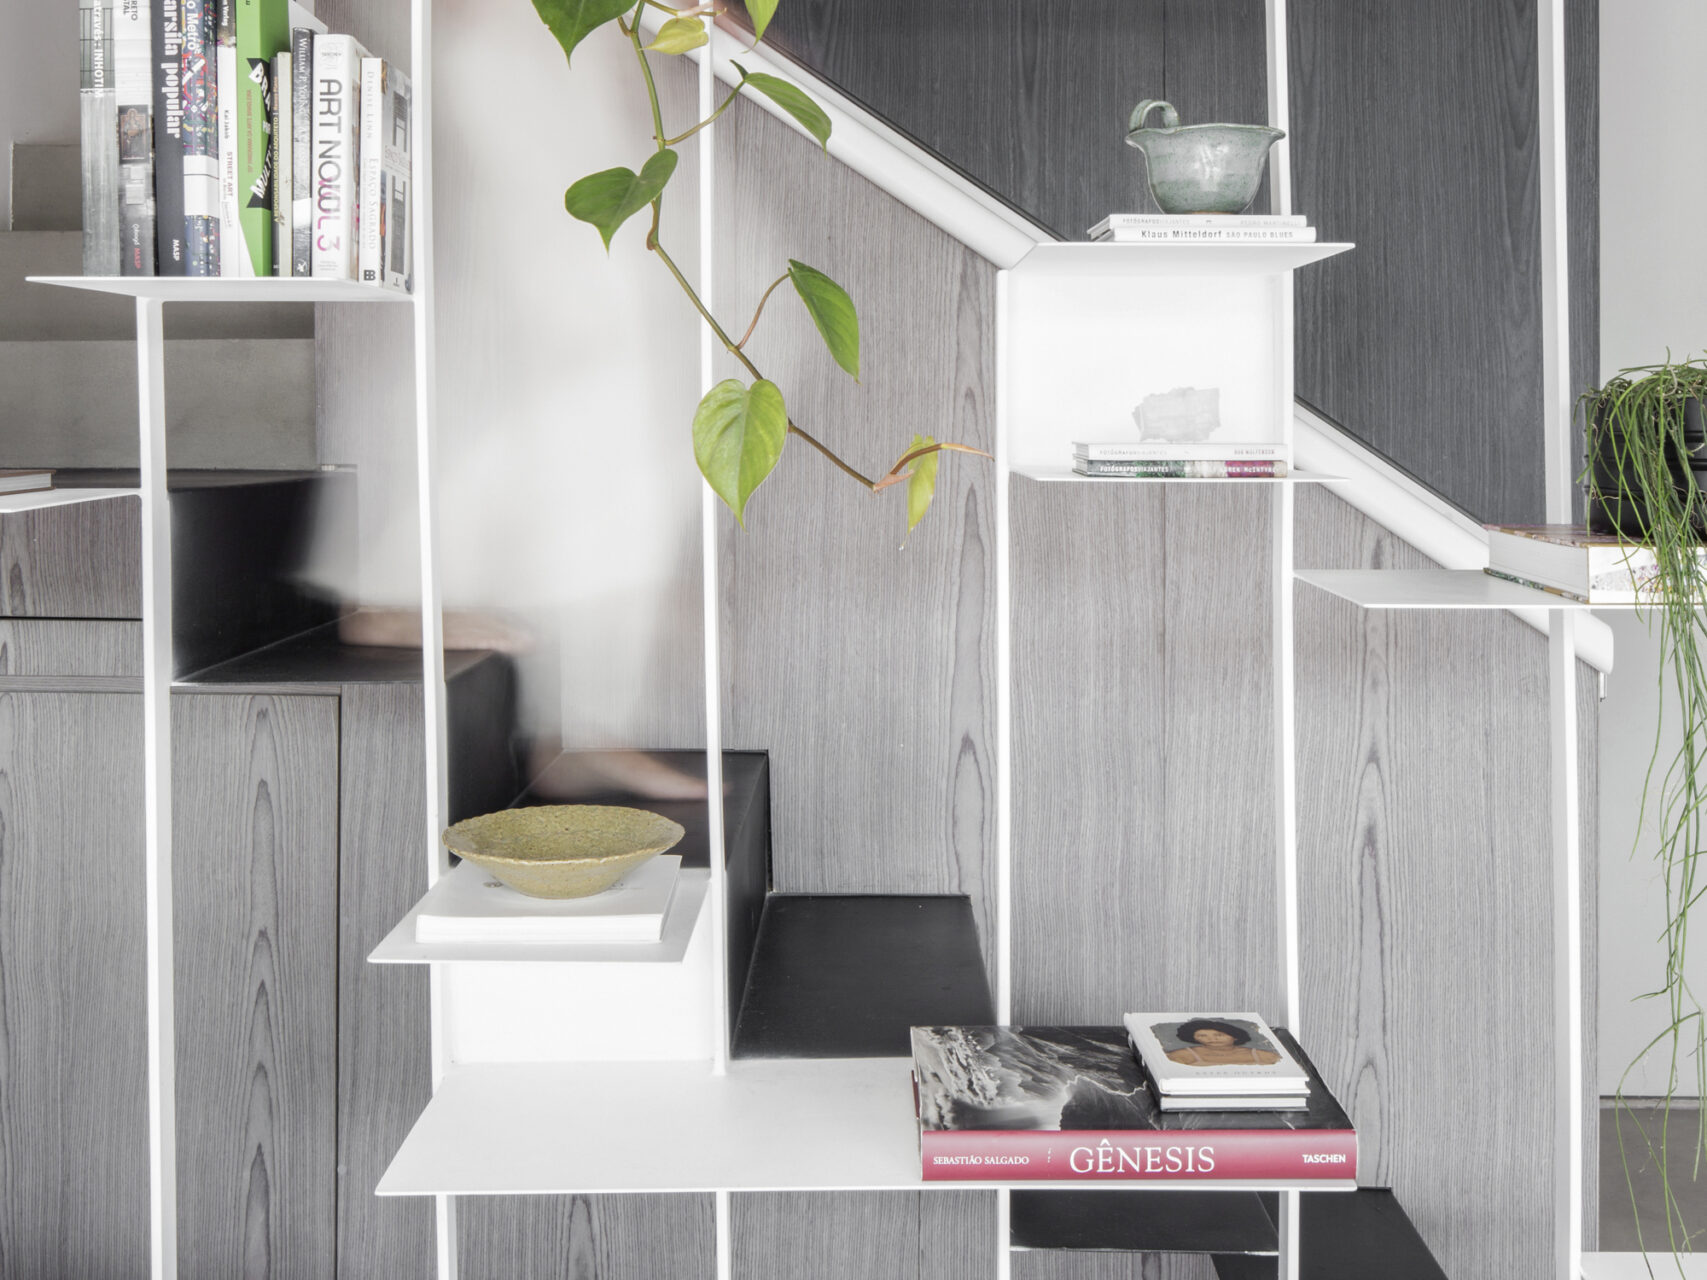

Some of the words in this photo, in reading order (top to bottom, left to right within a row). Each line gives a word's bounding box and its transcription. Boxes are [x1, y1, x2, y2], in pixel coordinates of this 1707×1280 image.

[187, 13, 199, 51] Metrô
[94, 49, 104, 98] INHOTIM
[161, 63, 182, 139] popular
[319, 79, 342, 135] ART
[317, 234, 340, 251] 3
[1141, 230, 1168, 238] Klaus
[1173, 230, 1222, 238] Mitteldorf
[172, 239, 180, 261] MASP
[933, 1154, 982, 1165] SEBASTIÃO
[984, 1156, 1029, 1165] SALGADO
[1069, 1138, 1215, 1173] GÊNESIS
[1302, 1154, 1346, 1164] TASCHEN
